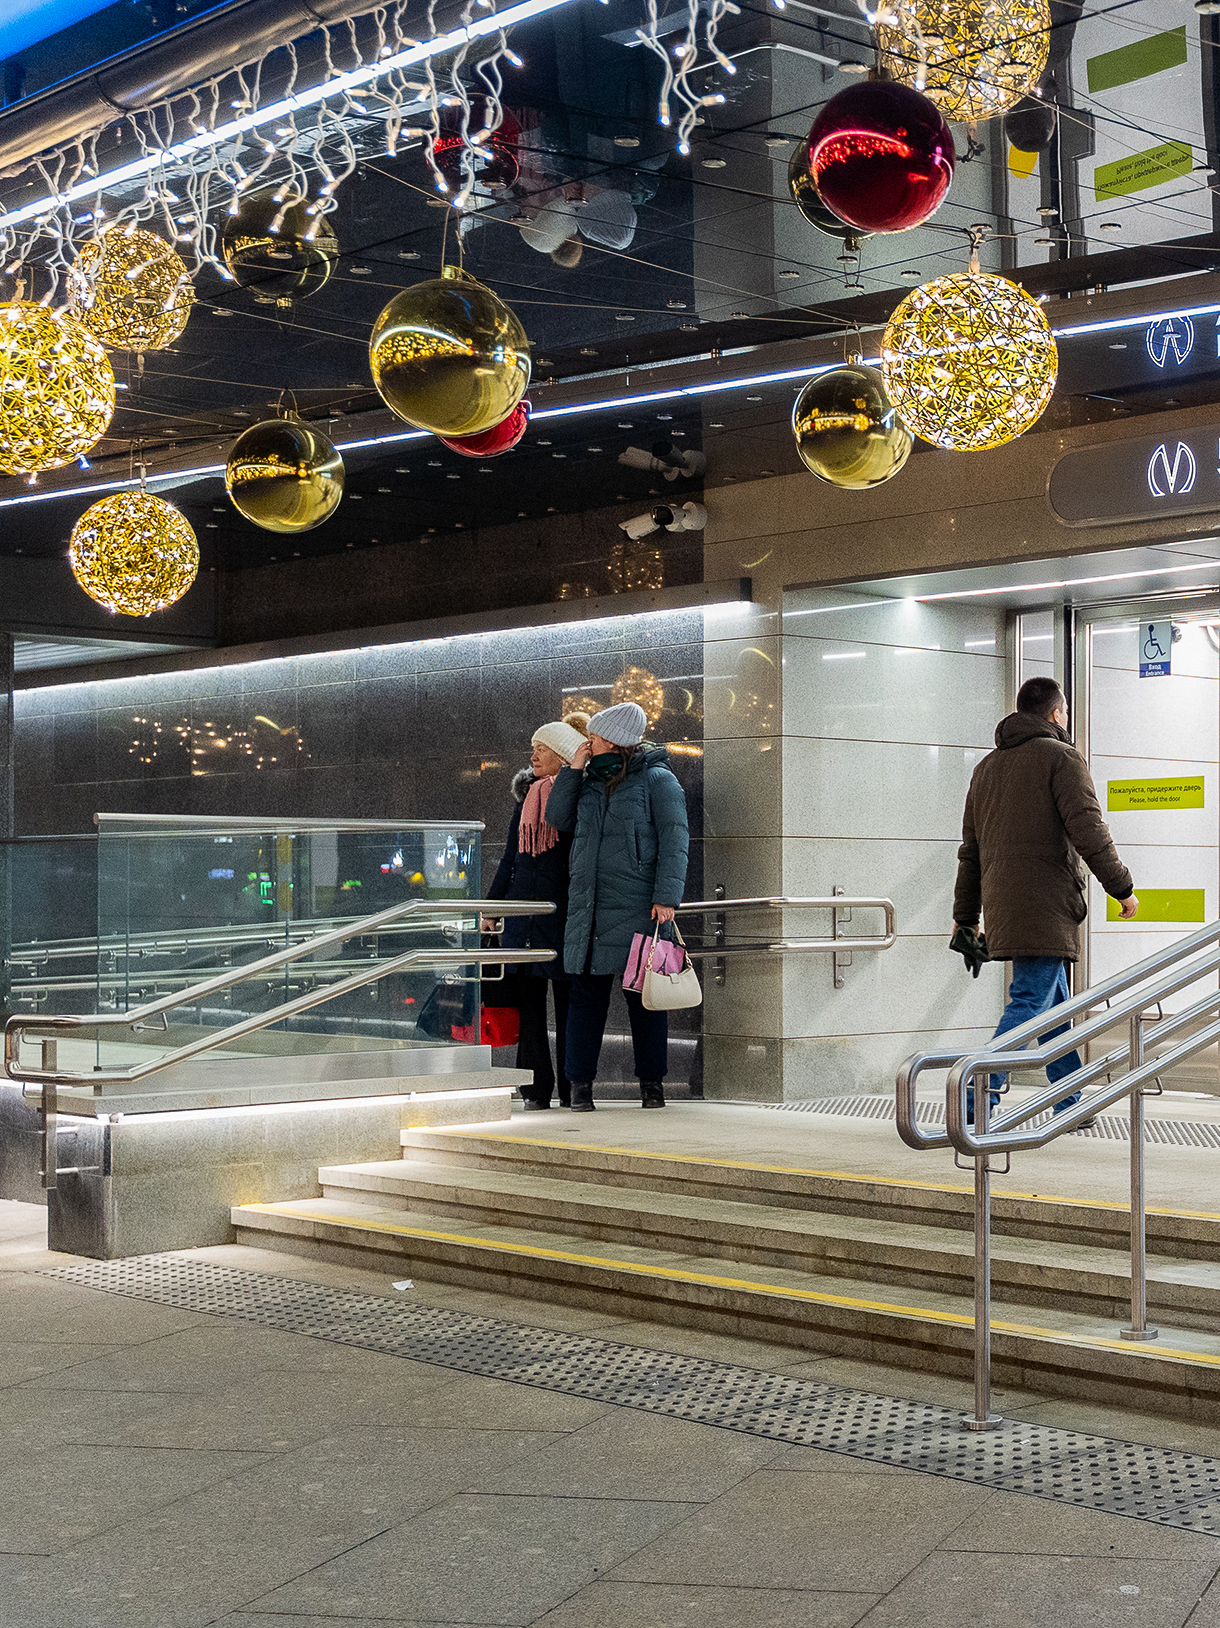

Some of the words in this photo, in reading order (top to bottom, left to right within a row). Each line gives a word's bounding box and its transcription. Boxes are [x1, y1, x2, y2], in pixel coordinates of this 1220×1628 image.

[1110, 786, 1146, 795] Пожалуйста,
[1147, 785, 1182, 793] придержите
[1183, 784, 1201, 792] дверь
